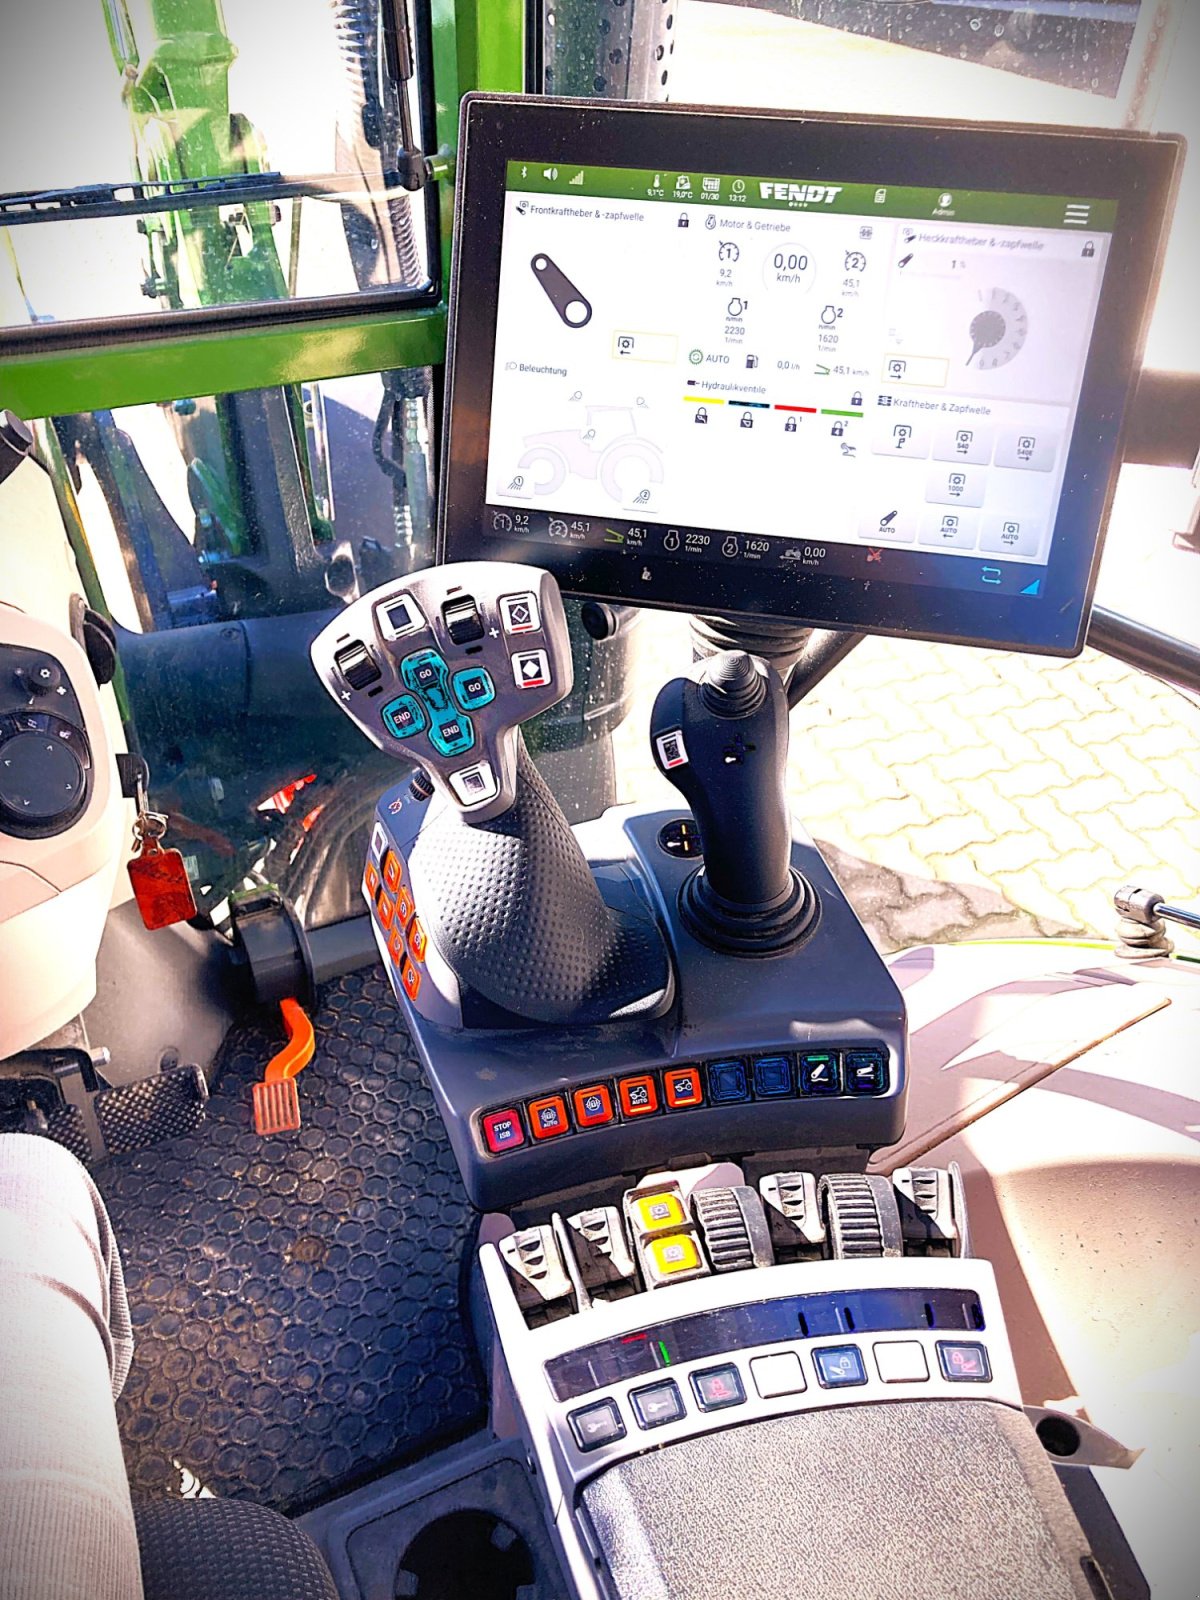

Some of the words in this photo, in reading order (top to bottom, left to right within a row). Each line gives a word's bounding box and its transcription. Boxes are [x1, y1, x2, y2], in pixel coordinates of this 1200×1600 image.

[759, 182, 843, 204] FENDT
[728, 194, 747, 203] 13:12
[530, 205, 593, 218] Frontkraftheber
[595, 210, 601, 218] &
[602, 211, 645, 222] -zapfwelle
[720, 218, 745, 230] Motor
[746, 221, 752, 230] &
[754, 221, 791, 233] Getriebe
[918, 232, 987, 247] Heckkraftheber
[989, 237, 996, 247] &
[773, 253, 808, 271] 0,00
[851, 257, 859, 269] 2
[719, 269, 732, 279] 9,2
[776, 273, 801, 283] km/h
[843, 278, 860, 289] 45,1
[836, 308, 844, 318] 2
[724, 325, 745, 336] 2230
[724, 337, 743, 345] 1/min
[818, 334, 839, 344] 1620
[818, 345, 836, 353] 1/min
[706, 354, 730, 364] AUTO
[519, 363, 568, 377] Beleuchtung
[777, 360, 790, 370] 0,0
[833, 365, 851, 375] 45,1
[852, 369, 870, 377] km/h
[701, 380, 767, 394] Hydraulikventile
[893, 397, 940, 411] Kraftheber
[941, 402, 948, 412] &
[948, 403, 992, 416] Zapfwelle
[948, 485, 964, 493] 1000
[515, 514, 529, 526] 9,2
[514, 525, 530, 534] km/h
[570, 521, 590, 532] 45,1
[878, 526, 895, 534] AUTO
[940, 526, 957, 534] AUTO
[569, 532, 586, 540] km/h
[627, 527, 647, 539] 45,1
[1001, 533, 1019, 541] AUTO
[626, 539, 643, 547] km/h
[685, 533, 711, 545] 2230
[684, 545, 702, 553] 1/min
[745, 540, 770, 552] 1620
[743, 552, 761, 560] 1/min
[804, 546, 826, 558] 0,00
[802, 558, 819, 566] km/h
[419, 668, 432, 679] GO
[468, 682, 482, 692] GO
[393, 711, 411, 724] END
[442, 725, 460, 737] END
[493, 1120, 512, 1132] STOP
[543, 1120, 558, 1128] AUTO
[499, 1130, 511, 1140] ISB
